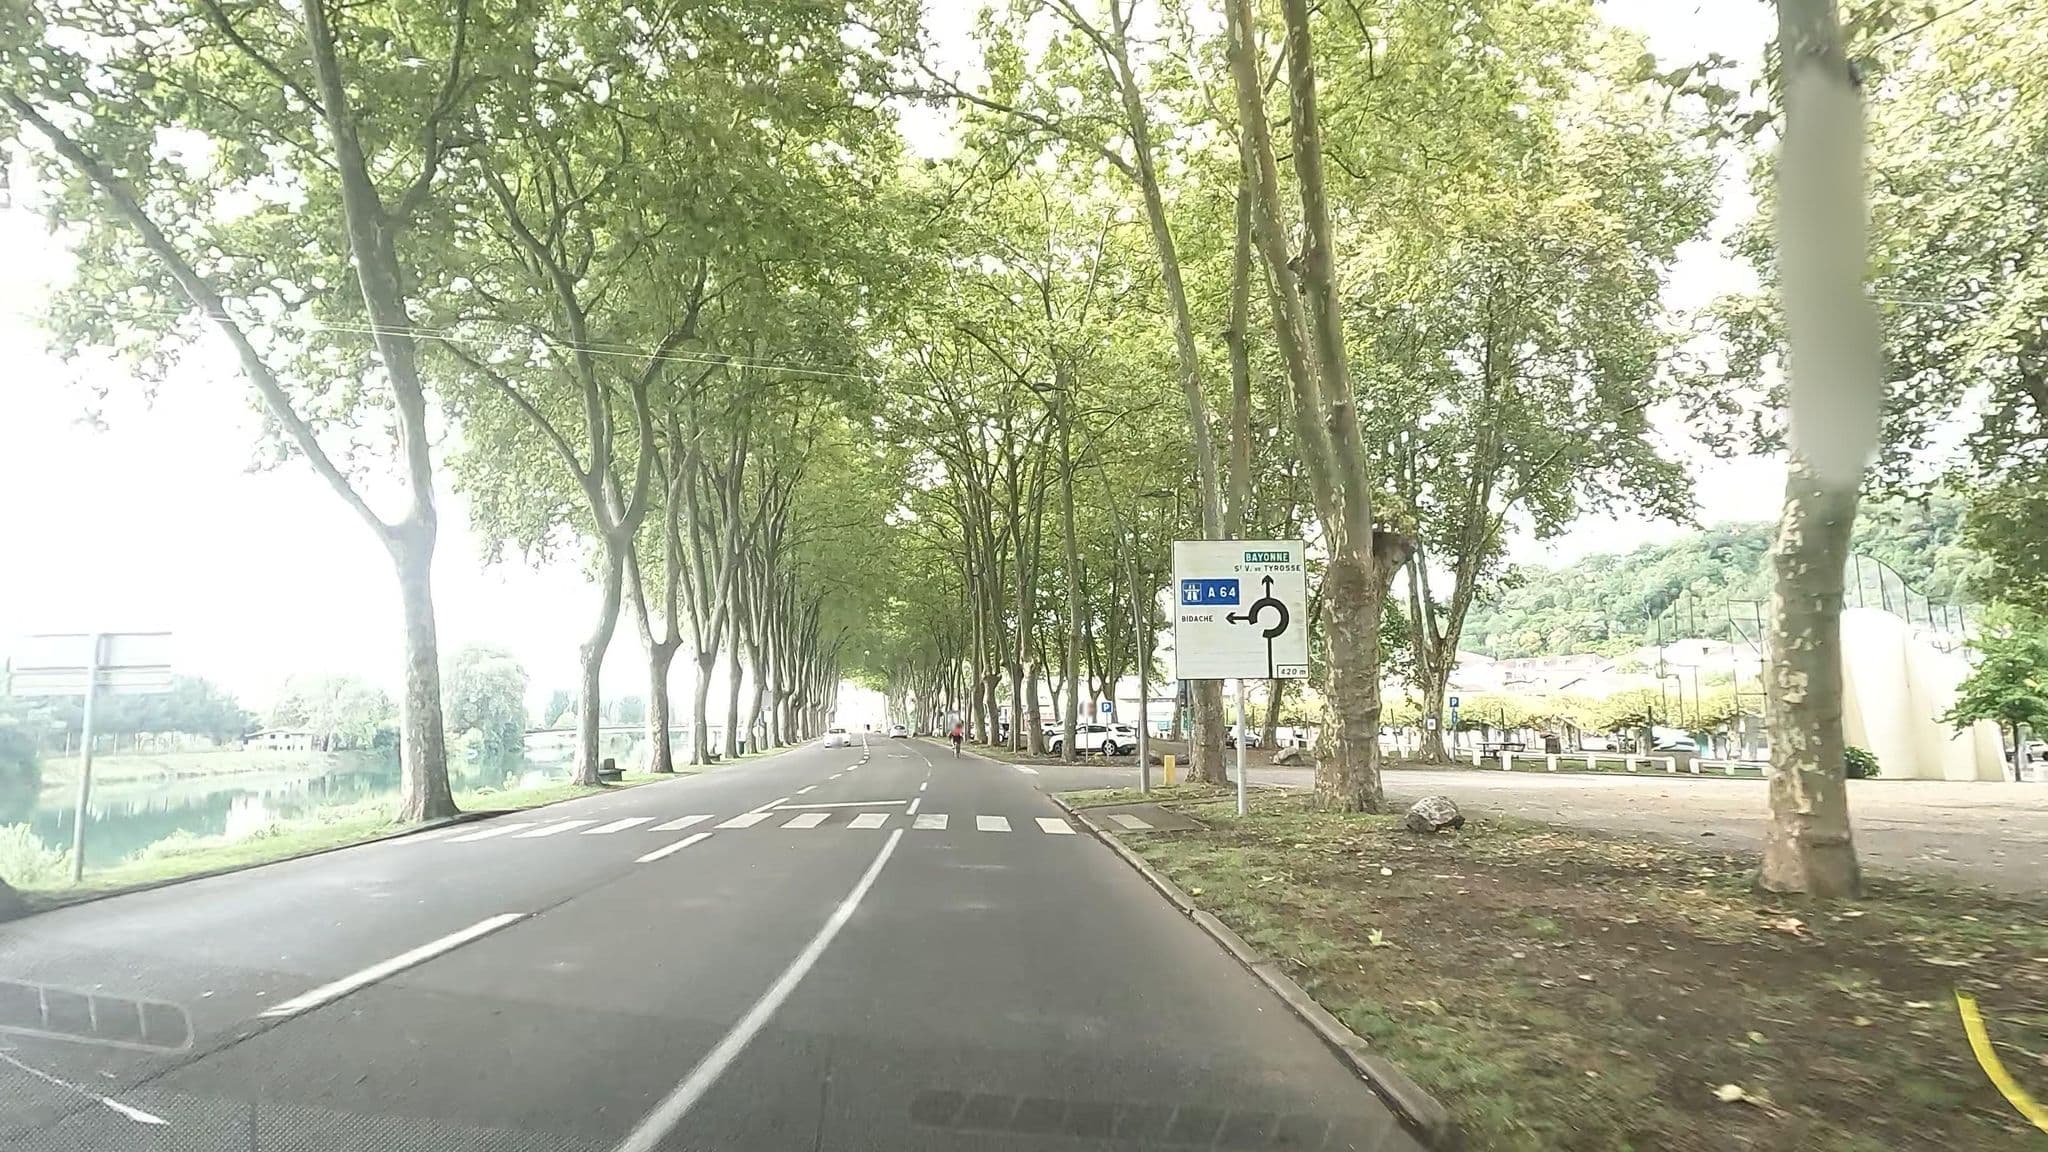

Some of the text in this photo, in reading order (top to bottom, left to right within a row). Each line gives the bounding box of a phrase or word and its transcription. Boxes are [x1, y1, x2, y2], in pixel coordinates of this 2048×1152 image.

[1246, 552, 1289, 562] BAYONNE
[1264, 564, 1301, 572] TYROSSE
[1208, 586, 1236, 597] A 64
[1181, 615, 1214, 623] BIDACHE
